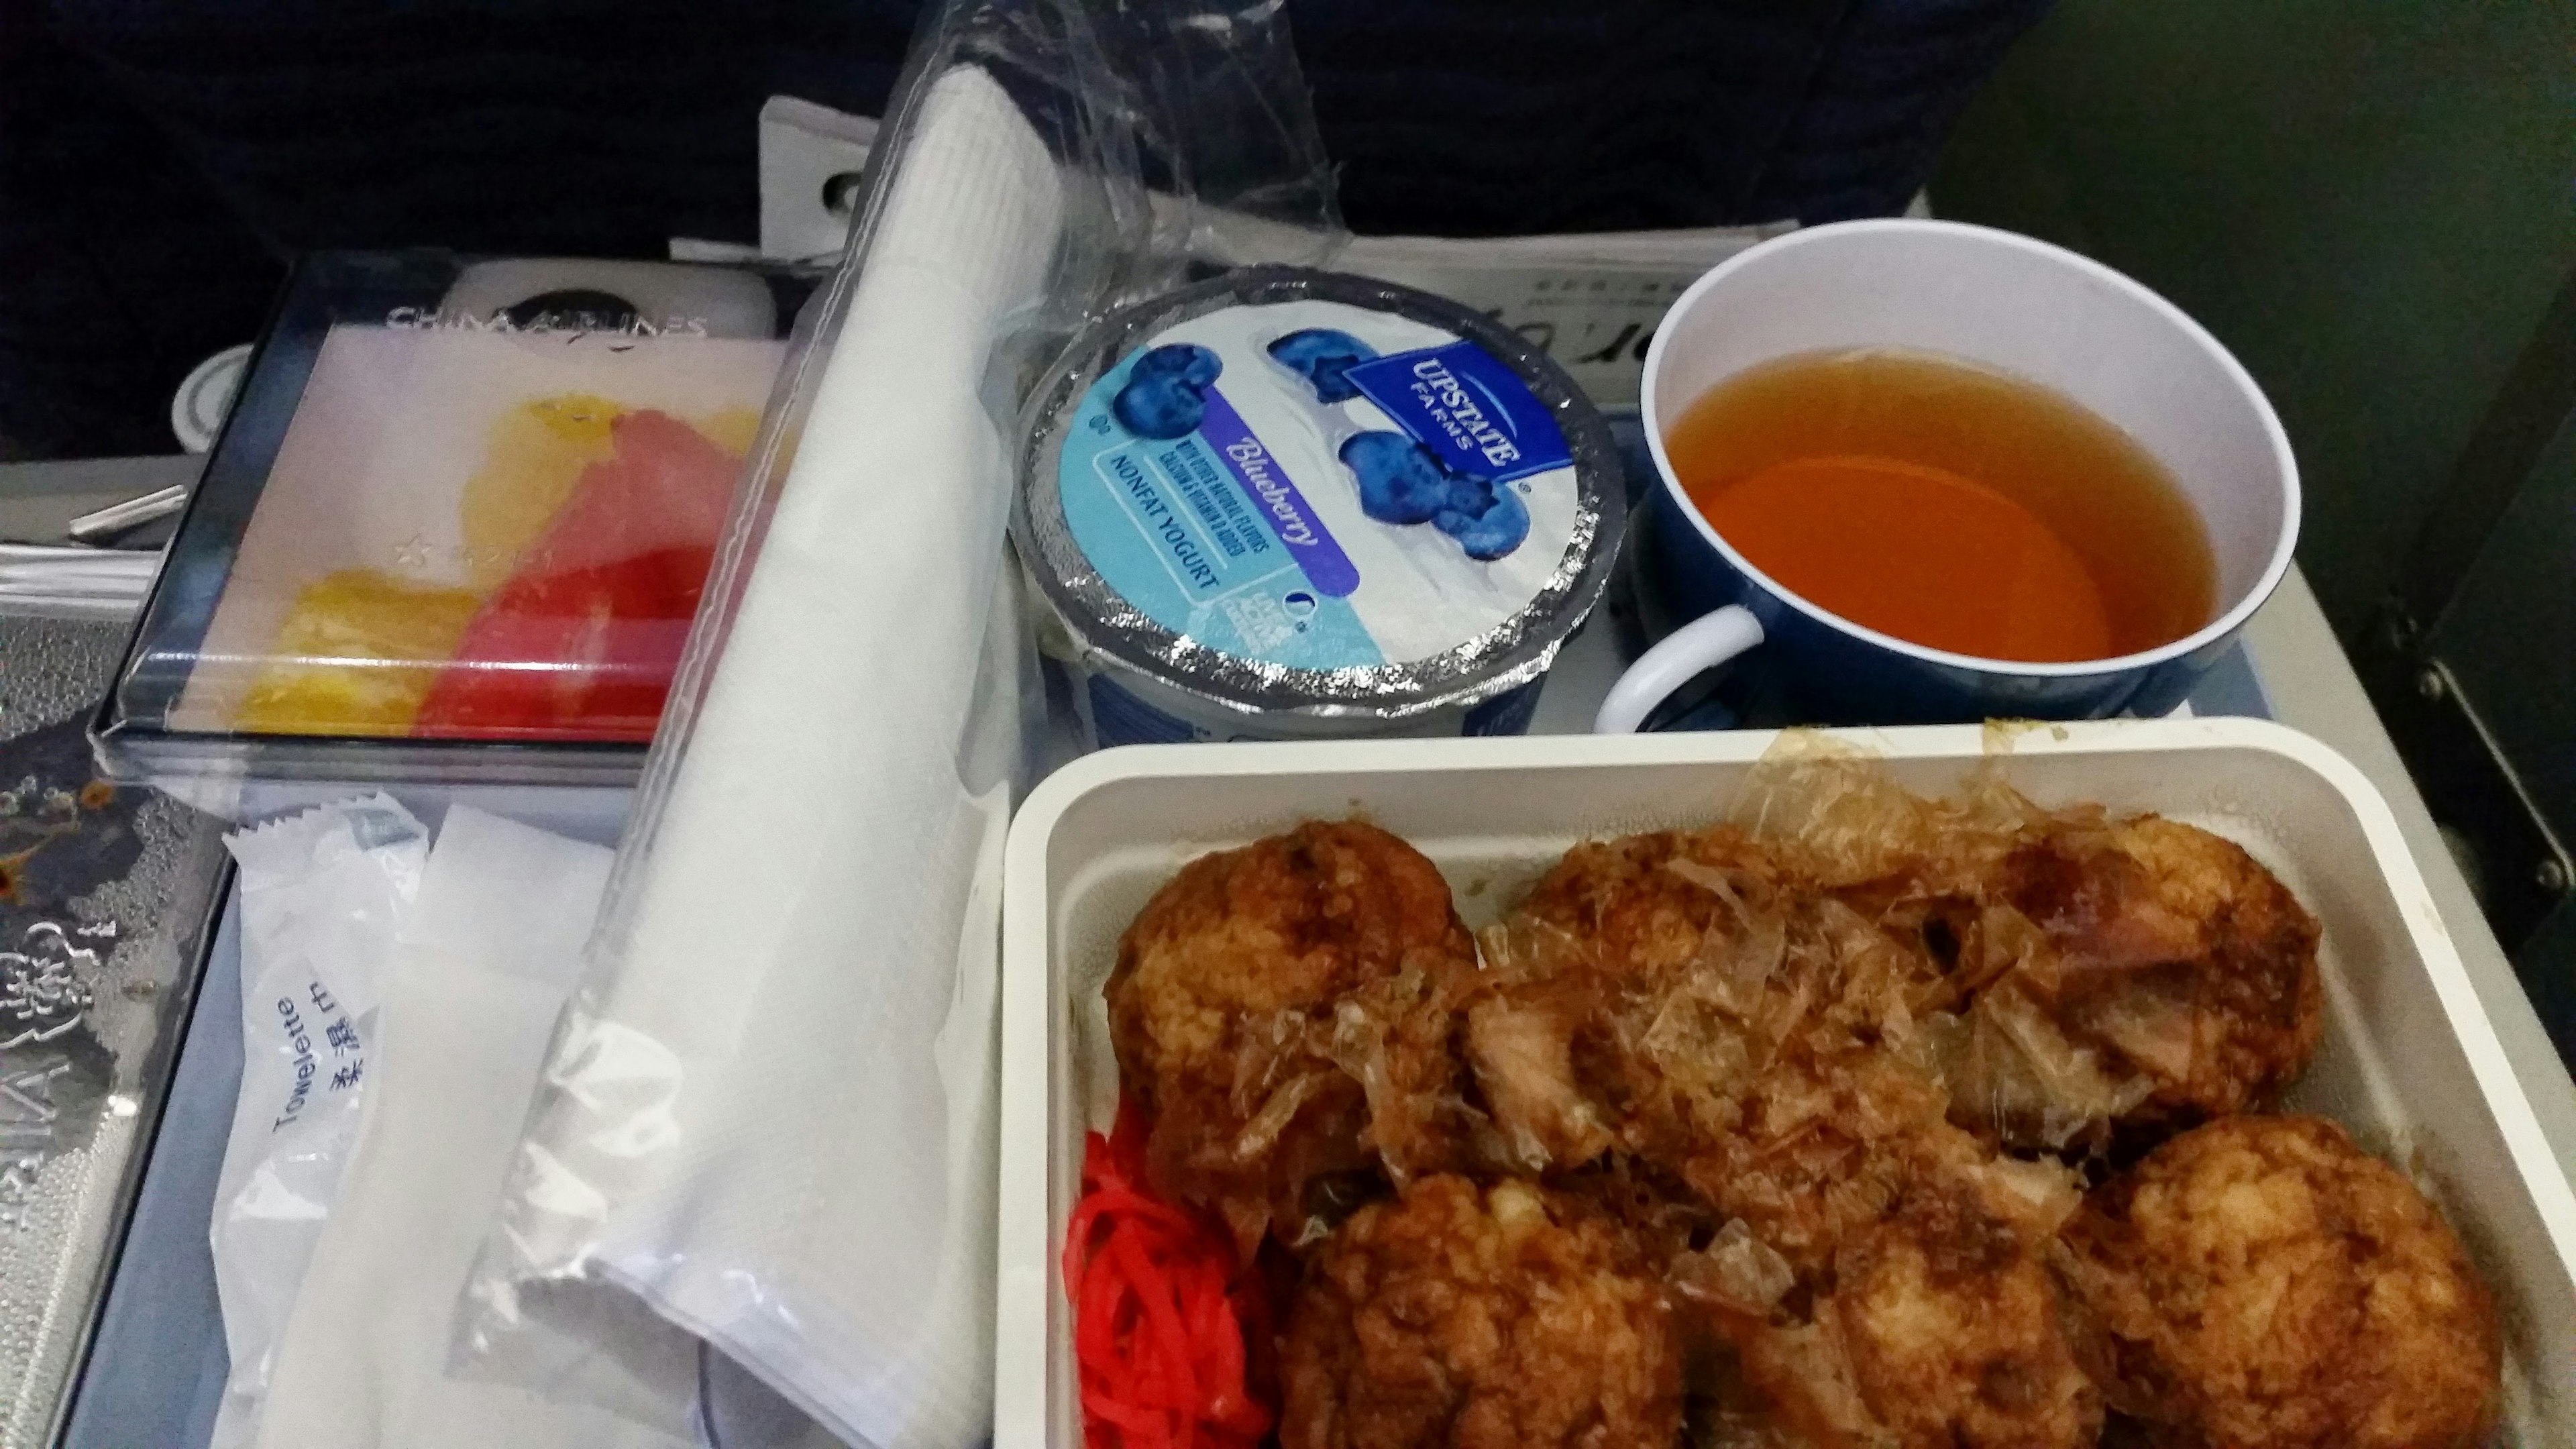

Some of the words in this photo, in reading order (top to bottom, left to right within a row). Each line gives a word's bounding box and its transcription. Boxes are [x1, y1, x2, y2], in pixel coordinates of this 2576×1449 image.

[1410, 382, 1474, 451] FARMS
[1413, 358, 1521, 467] UPSTATE
[1110, 454, 1169, 518] NONFAT
[1159, 516, 1220, 590] YOGURT
[1226, 437, 1318, 546] Blueberry
[272, 997, 315, 1132] Towelette
